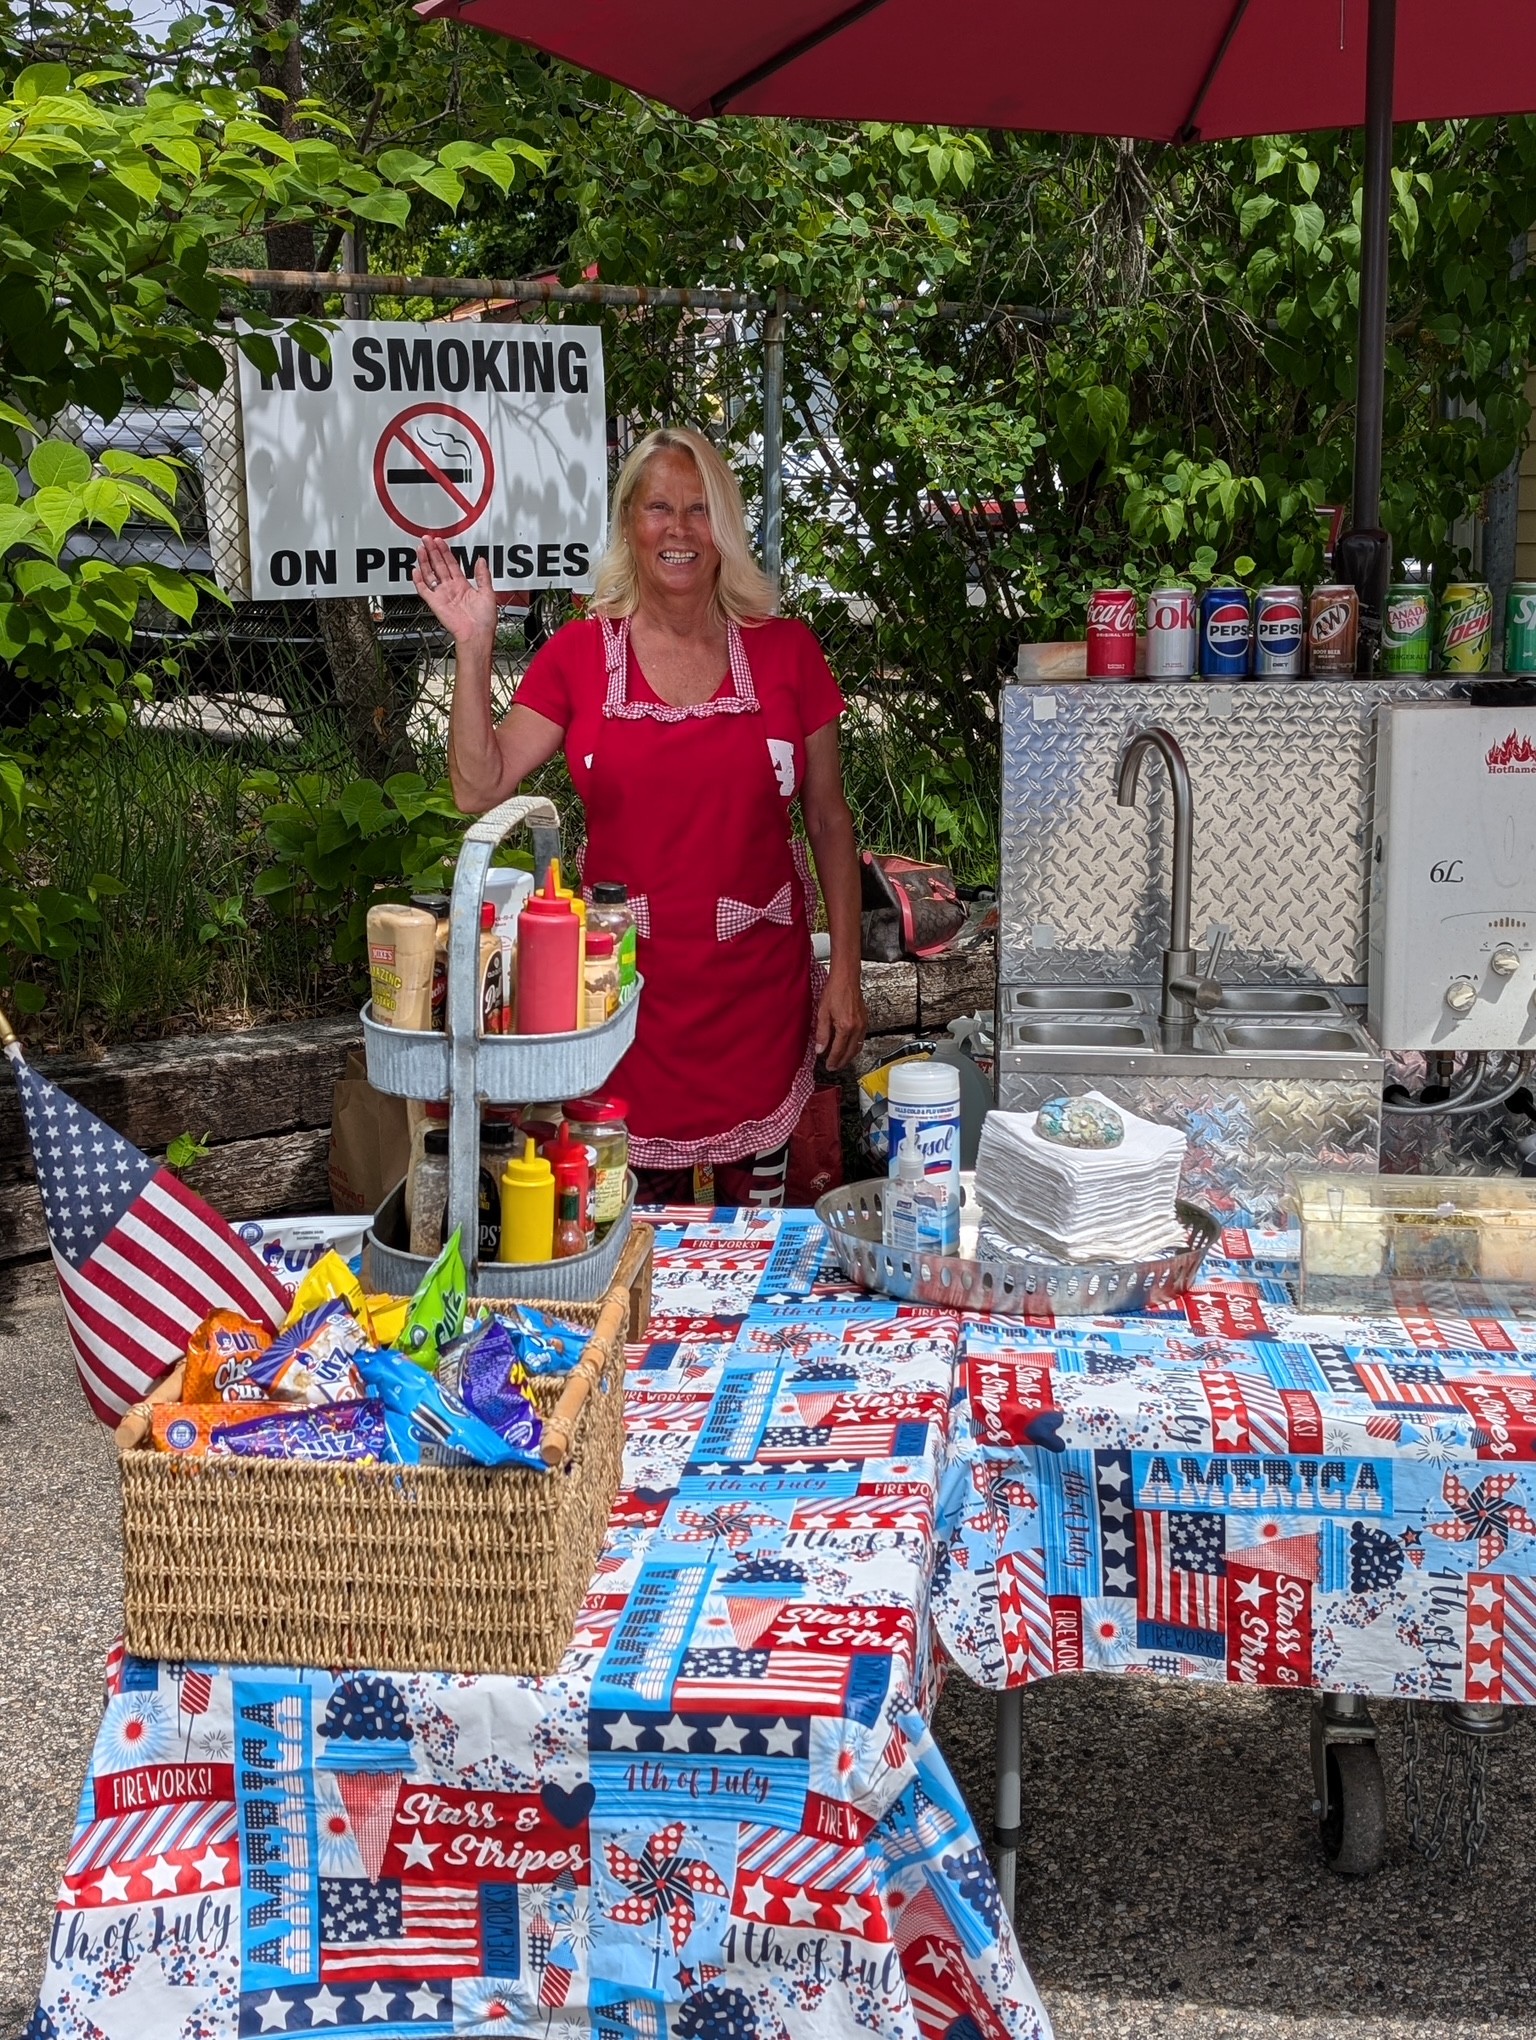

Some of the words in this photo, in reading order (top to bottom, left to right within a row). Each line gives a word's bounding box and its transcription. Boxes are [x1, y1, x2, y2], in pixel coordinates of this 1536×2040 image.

[260, 337, 333, 392] NO
[352, 336, 589, 394] SMOKING
[269, 548, 337, 587] ON
[355, 542, 590, 584] PRMISES
[1387, 604, 1429, 625] CANADA
[1398, 615, 1422, 630] DRY
[692, 1240, 760, 1249] FIREWORKS!
[775, 1477, 829, 1492] July
[1138, 1456, 1385, 1511] AMERICA
[1428, 1565, 1469, 1622] 4th
[1275, 1574, 1306, 1660] Stars
[1421, 1624, 1463, 1654] of
[1144, 1623, 1222, 1657] FIREWORKS
[1276, 1665, 1300, 1683] &
[113, 1767, 212, 1810] FIREWORKS!
[623, 1759, 670, 1793] 4th
[677, 1768, 700, 1798] of
[707, 1765, 772, 1804] July
[395, 1792, 504, 1829] Stars
[514, 1807, 541, 1832] &
[240, 1694, 311, 1976] AMERICA
[443, 1832, 592, 1879] Stripes
[103, 1909, 142, 1962] of
[150, 1894, 240, 1952] July
[487, 1884, 514, 1974] FIREWORKS
[719, 1922, 786, 1966] 4th
[797, 1933, 833, 1981] of
